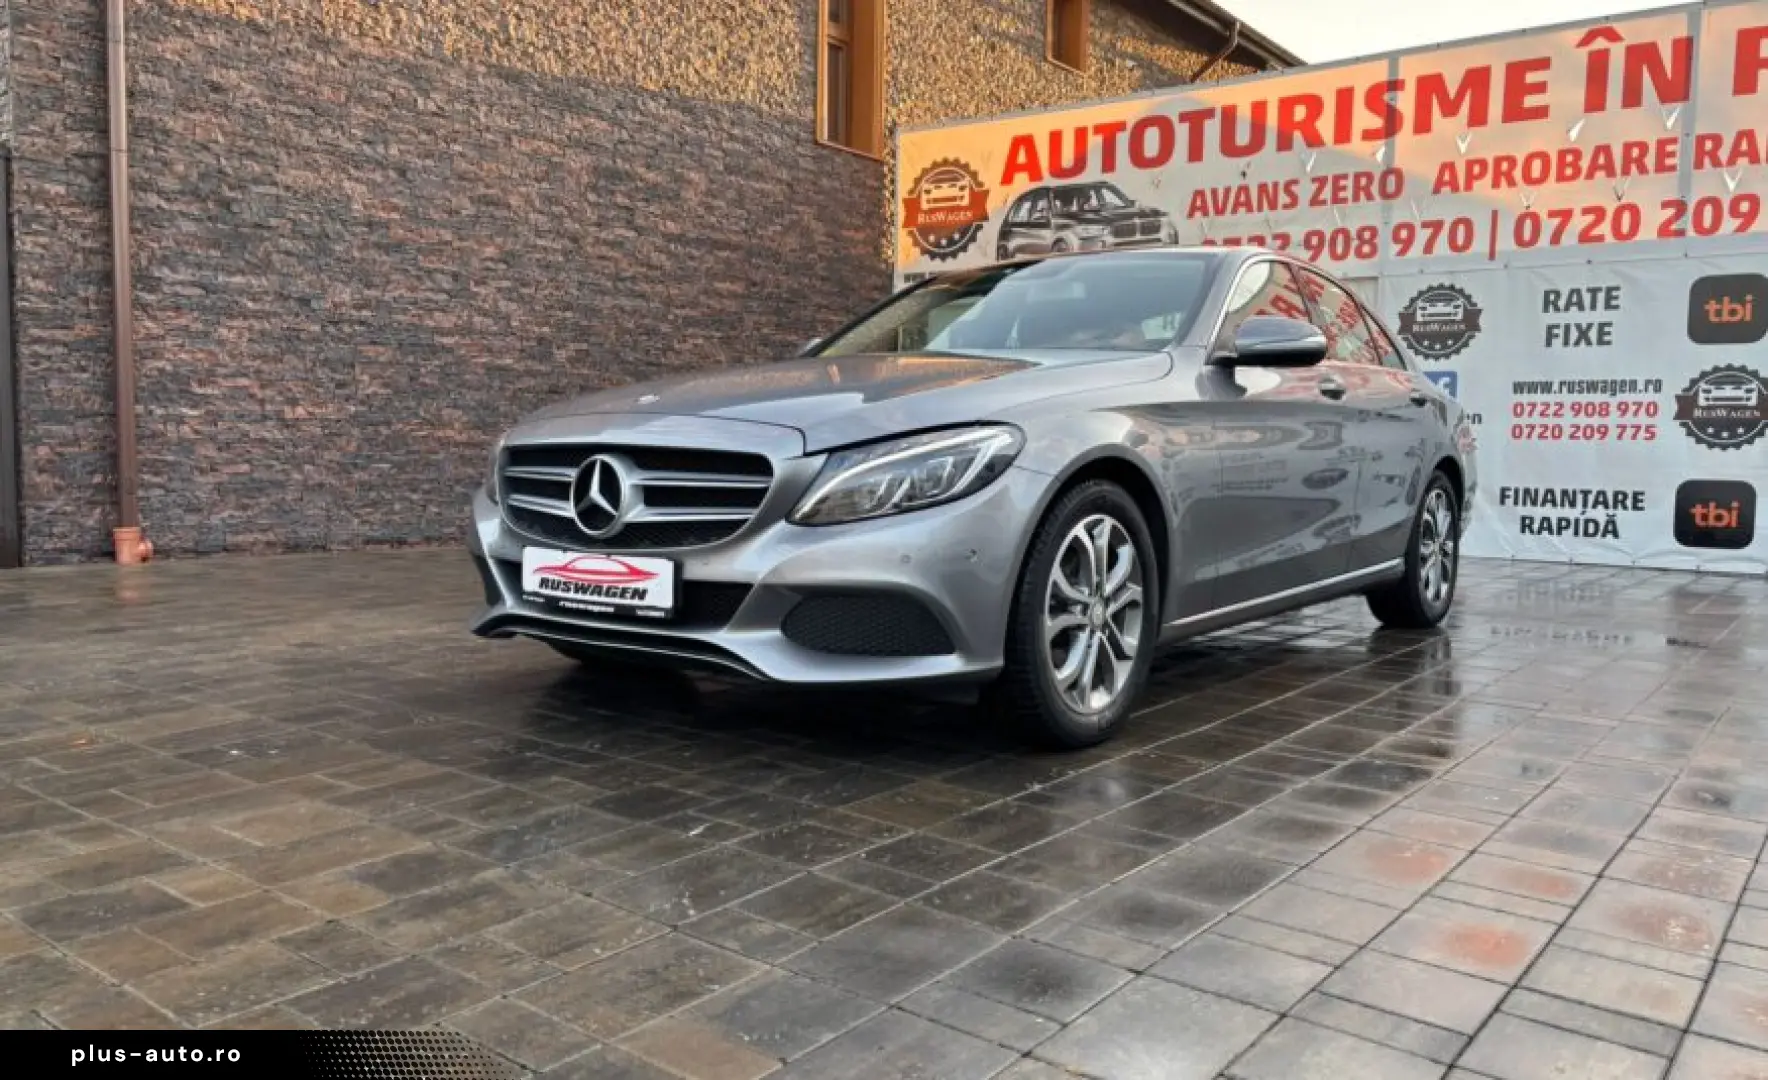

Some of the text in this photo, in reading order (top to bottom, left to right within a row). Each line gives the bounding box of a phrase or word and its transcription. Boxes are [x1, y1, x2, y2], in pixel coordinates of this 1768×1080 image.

[1000, 57, 1551, 186] AUTOTURISME
[1576, 26, 1693, 113] ÎN
[1187, 129, 1768, 219] AVANS ZERO APROBARE RA
[1303, 225, 1379, 262] 908
[1391, 216, 1473, 256] 970
[1513, 202, 1641, 248] 0720
[1657, 193, 1760, 239] 209
[1542, 286, 1621, 313] RATE
[1704, 295, 1753, 323] tbi
[1545, 322, 1613, 347] FIXE
[1513, 379, 1662, 396] www.ruswagen.ro
[1512, 401, 1658, 418] 0722 908 970
[1511, 424, 1656, 440] 0720 209 775
[1500, 486, 1646, 515] FINANȚARE
[1520, 514, 1620, 539] RAPIDĂ
[1690, 502, 1740, 528] tbi
[539, 577, 648, 600] RUSWAGEN
